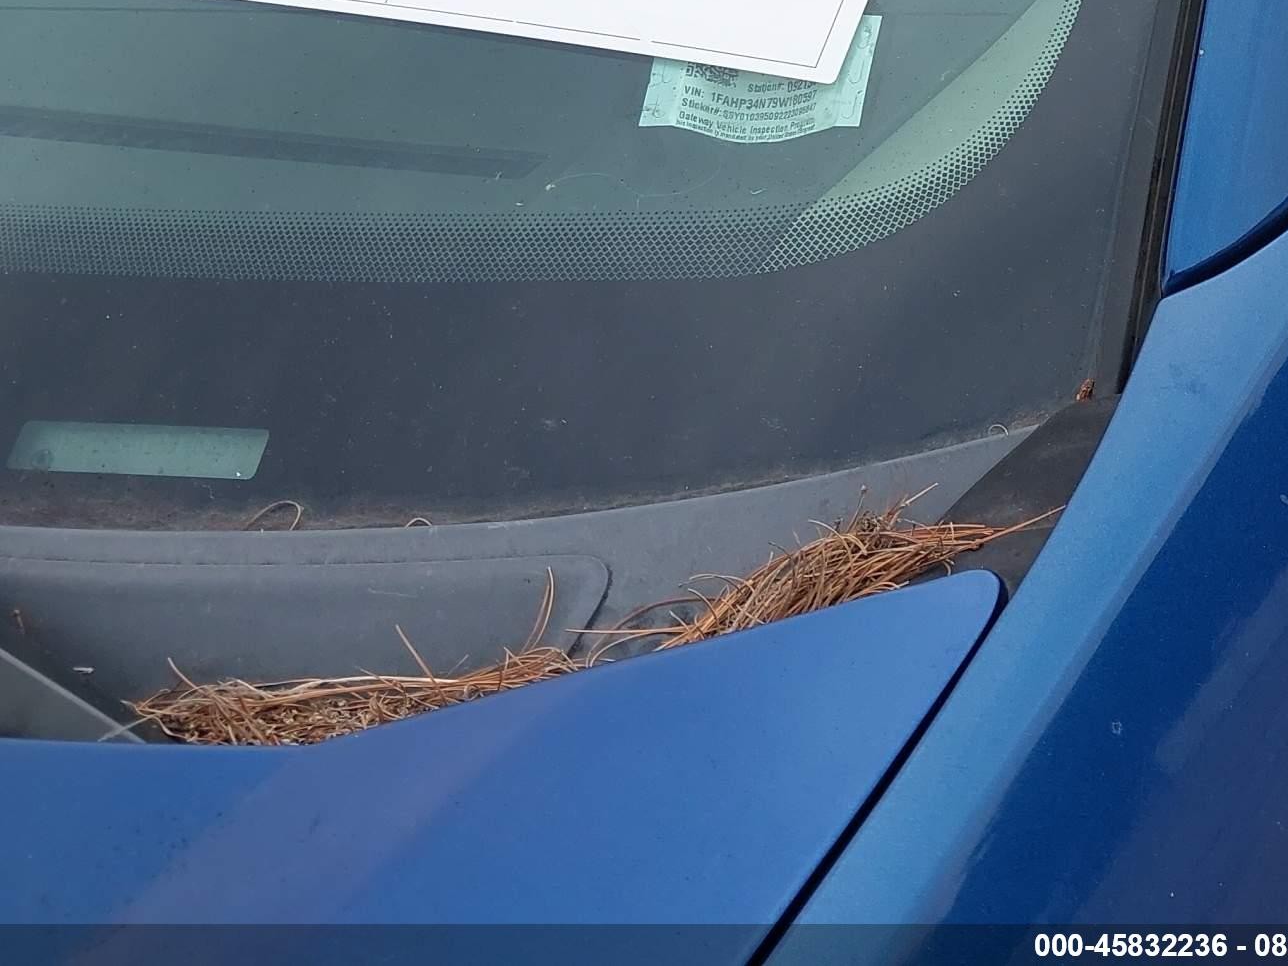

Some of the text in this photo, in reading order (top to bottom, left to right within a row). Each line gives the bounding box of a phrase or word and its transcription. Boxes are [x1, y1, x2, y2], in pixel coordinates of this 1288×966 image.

[683, 85, 705, 100] VIN:
[678, 111, 715, 130] Gateway
[716, 120, 748, 134] Vehicle
